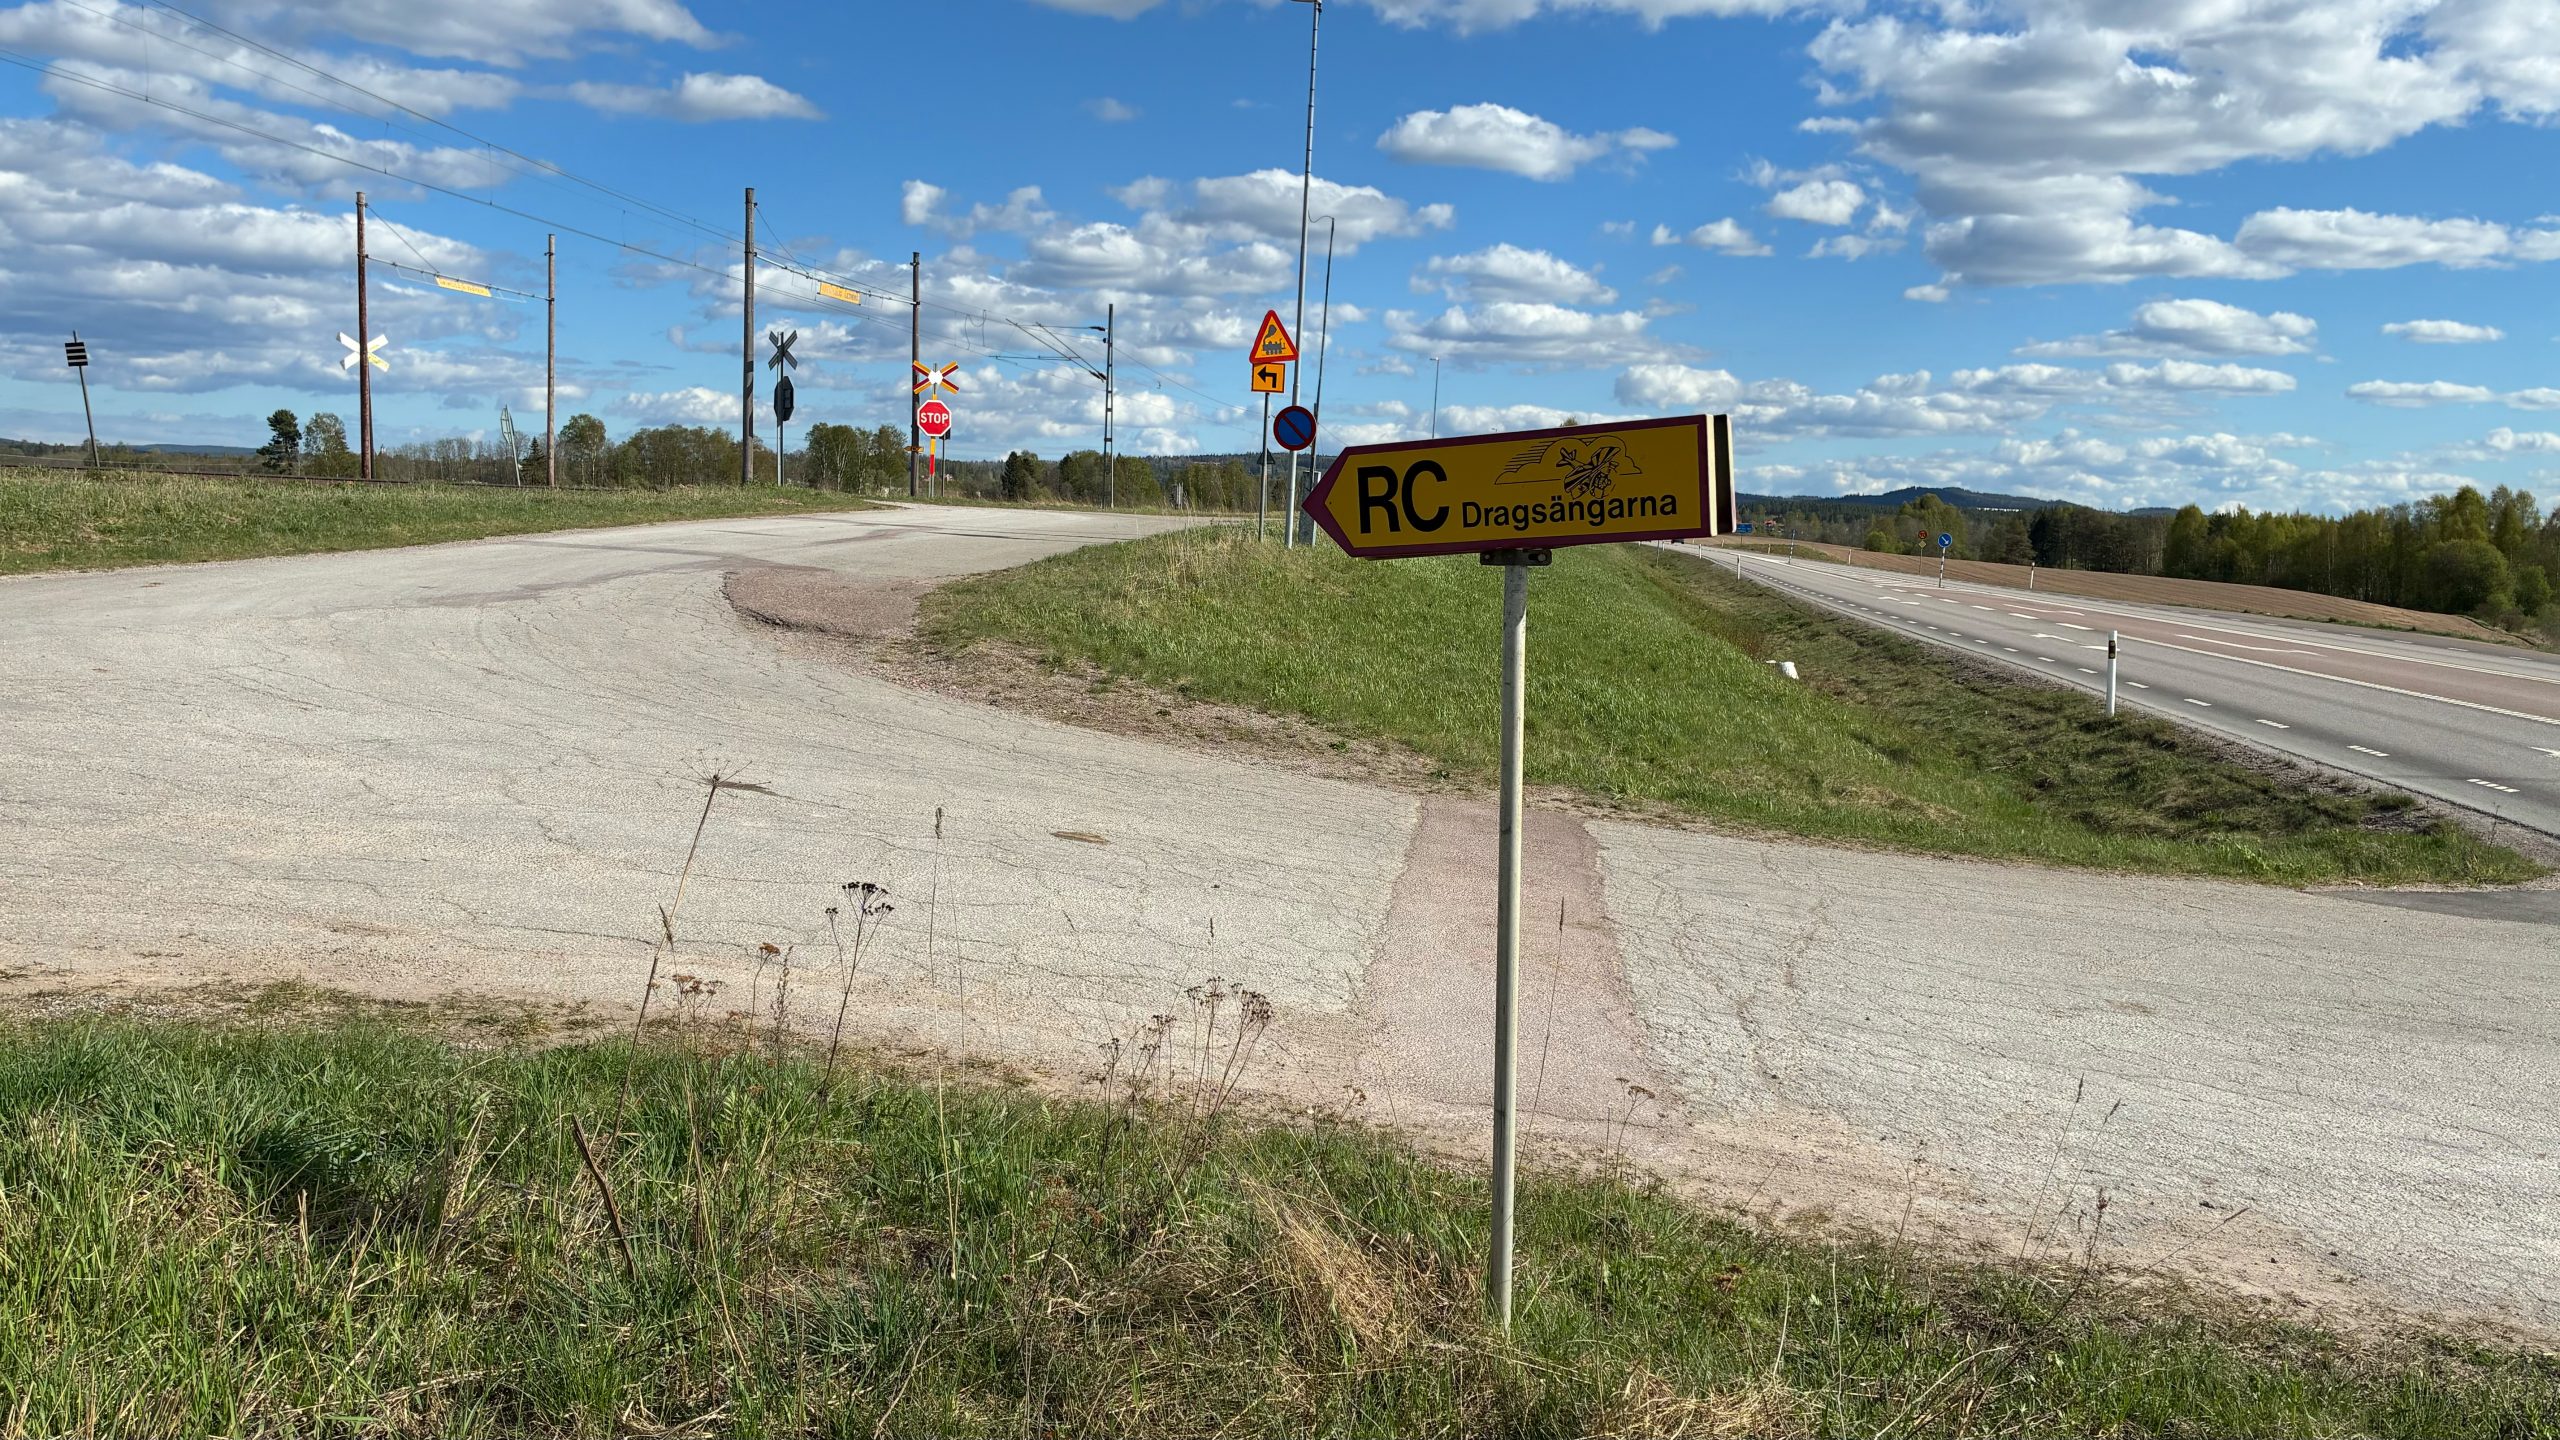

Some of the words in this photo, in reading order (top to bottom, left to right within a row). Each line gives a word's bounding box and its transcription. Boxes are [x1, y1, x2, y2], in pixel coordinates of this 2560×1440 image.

[920, 412, 949, 425] STOP
[1356, 460, 1450, 534] RC
[1462, 493, 1678, 532] Dragsängarna
